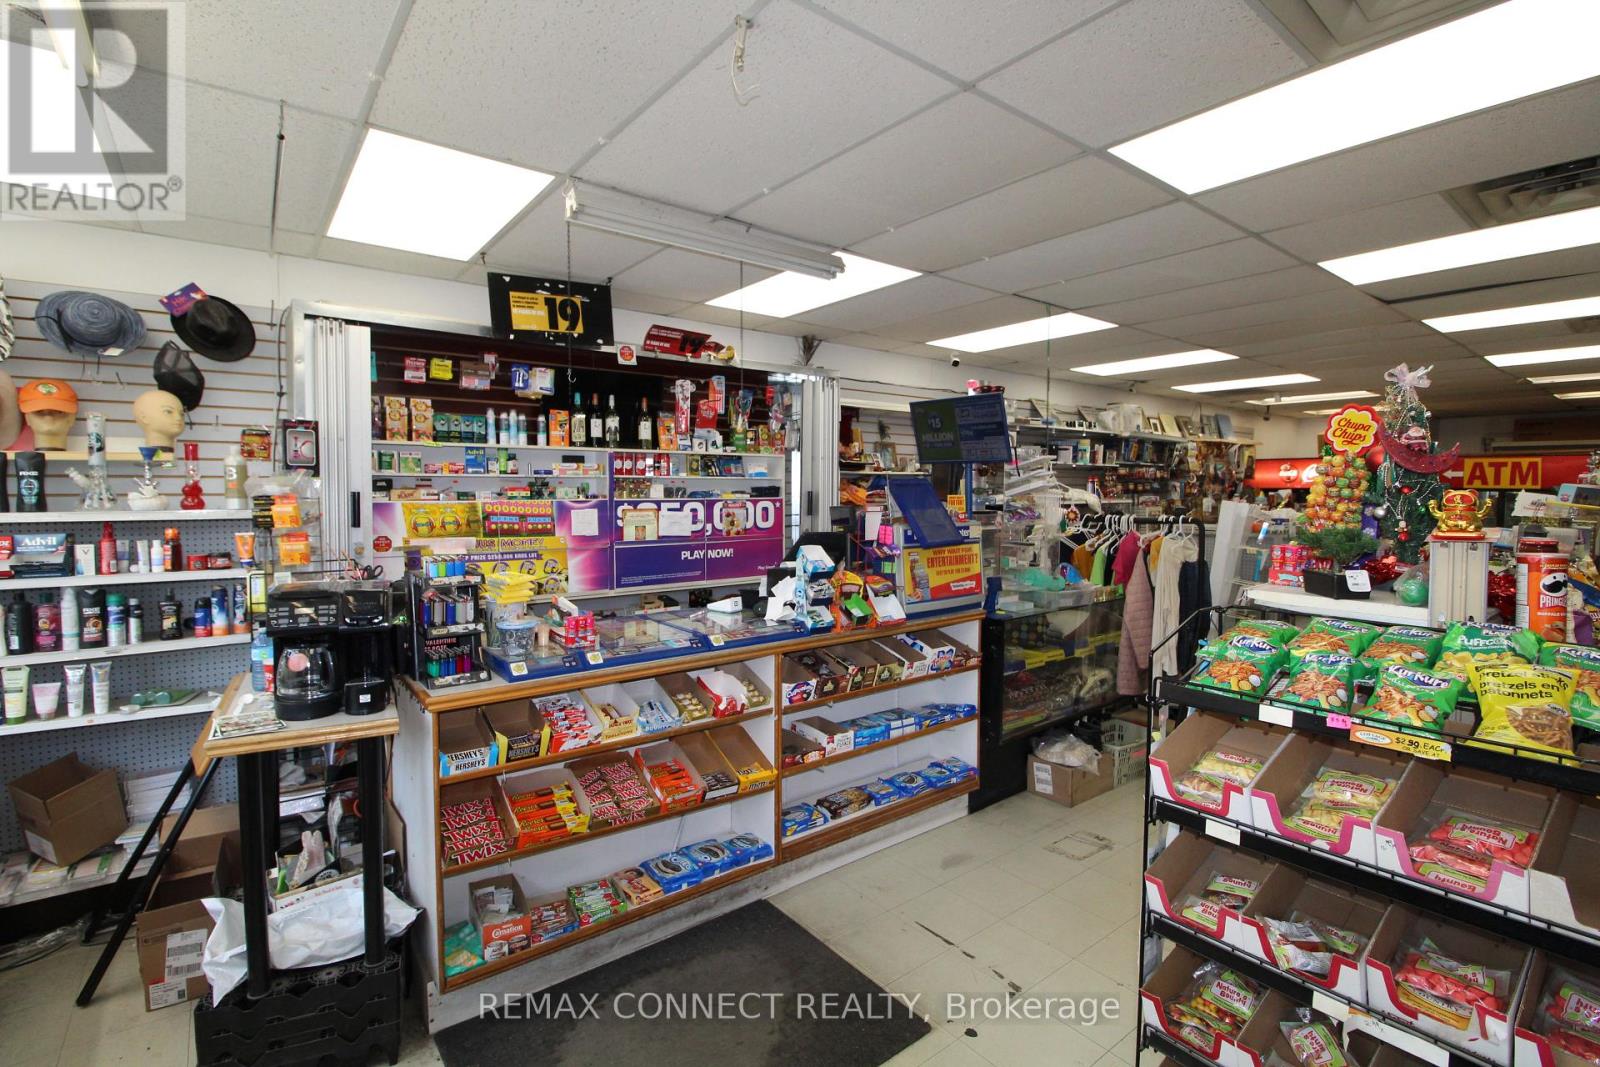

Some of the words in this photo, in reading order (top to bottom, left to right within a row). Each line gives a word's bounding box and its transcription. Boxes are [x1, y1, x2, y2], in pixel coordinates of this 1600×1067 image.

[544, 297, 581, 331] 19
[1337, 417, 1372, 434] Chupa
[1332, 427, 1367, 445] Chups
[1466, 461, 1540, 486] ATM
[21, 536, 58, 547] Advil
[681, 550, 705, 561] PLAY
[707, 548, 734, 559] NOW!
[1480, 680, 1537, 692] pretzels
[1541, 682, 1560, 693] en
[455, 758, 486, 771] HERSHEY'S
